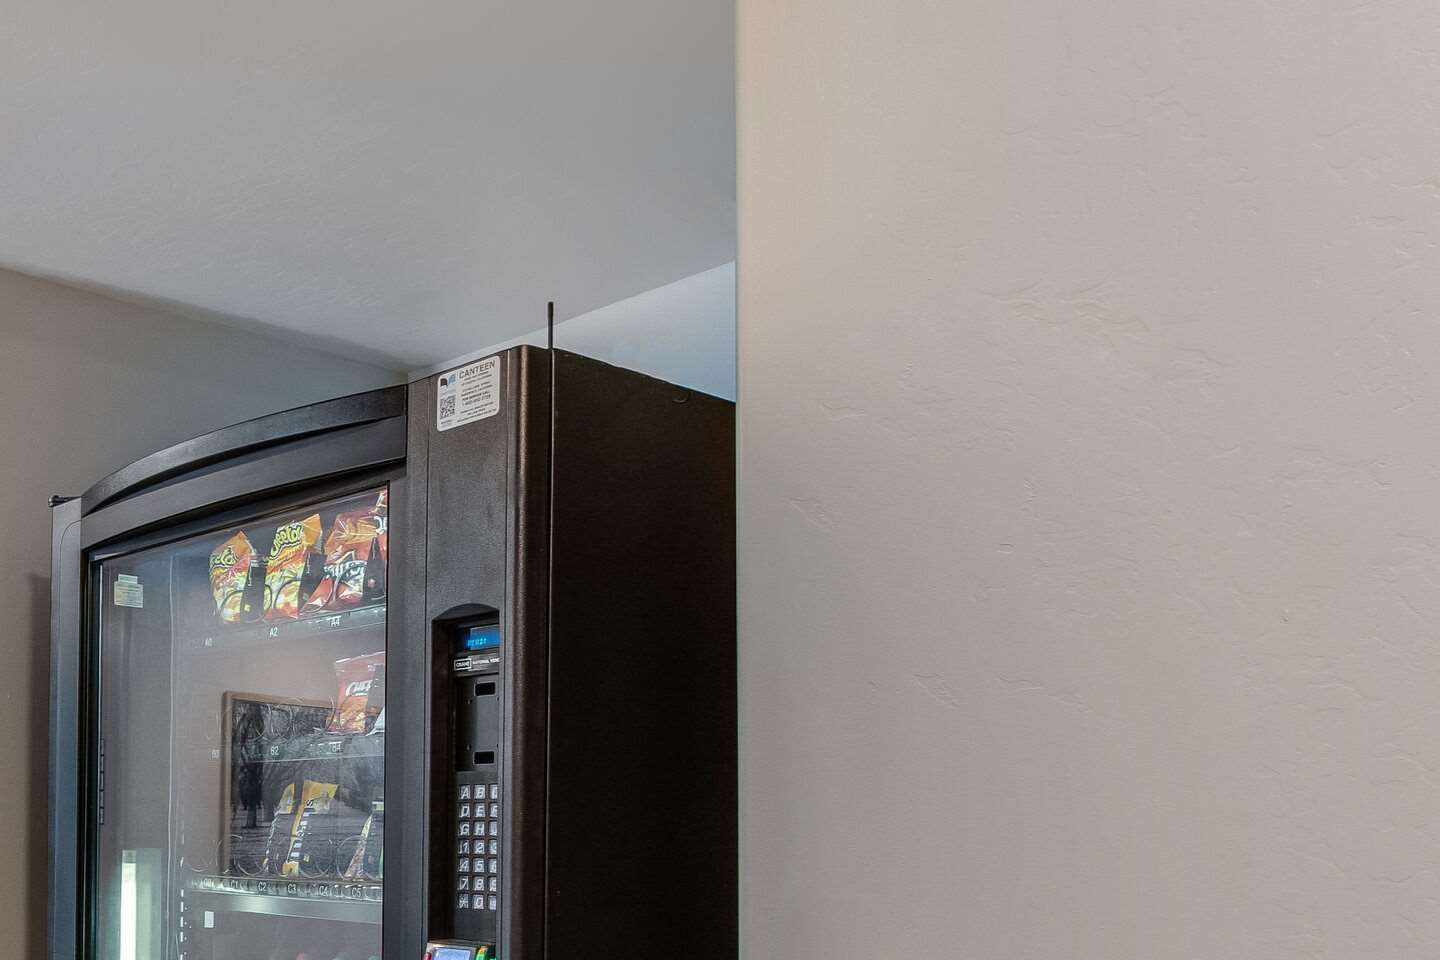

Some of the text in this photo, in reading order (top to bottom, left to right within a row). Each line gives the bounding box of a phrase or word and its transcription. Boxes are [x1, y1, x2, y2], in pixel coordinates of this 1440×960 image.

[459, 360, 495, 378] CANTEEN
[258, 881, 267, 892] C2
[287, 883, 297, 894] C3
[352, 887, 361, 898] C5
